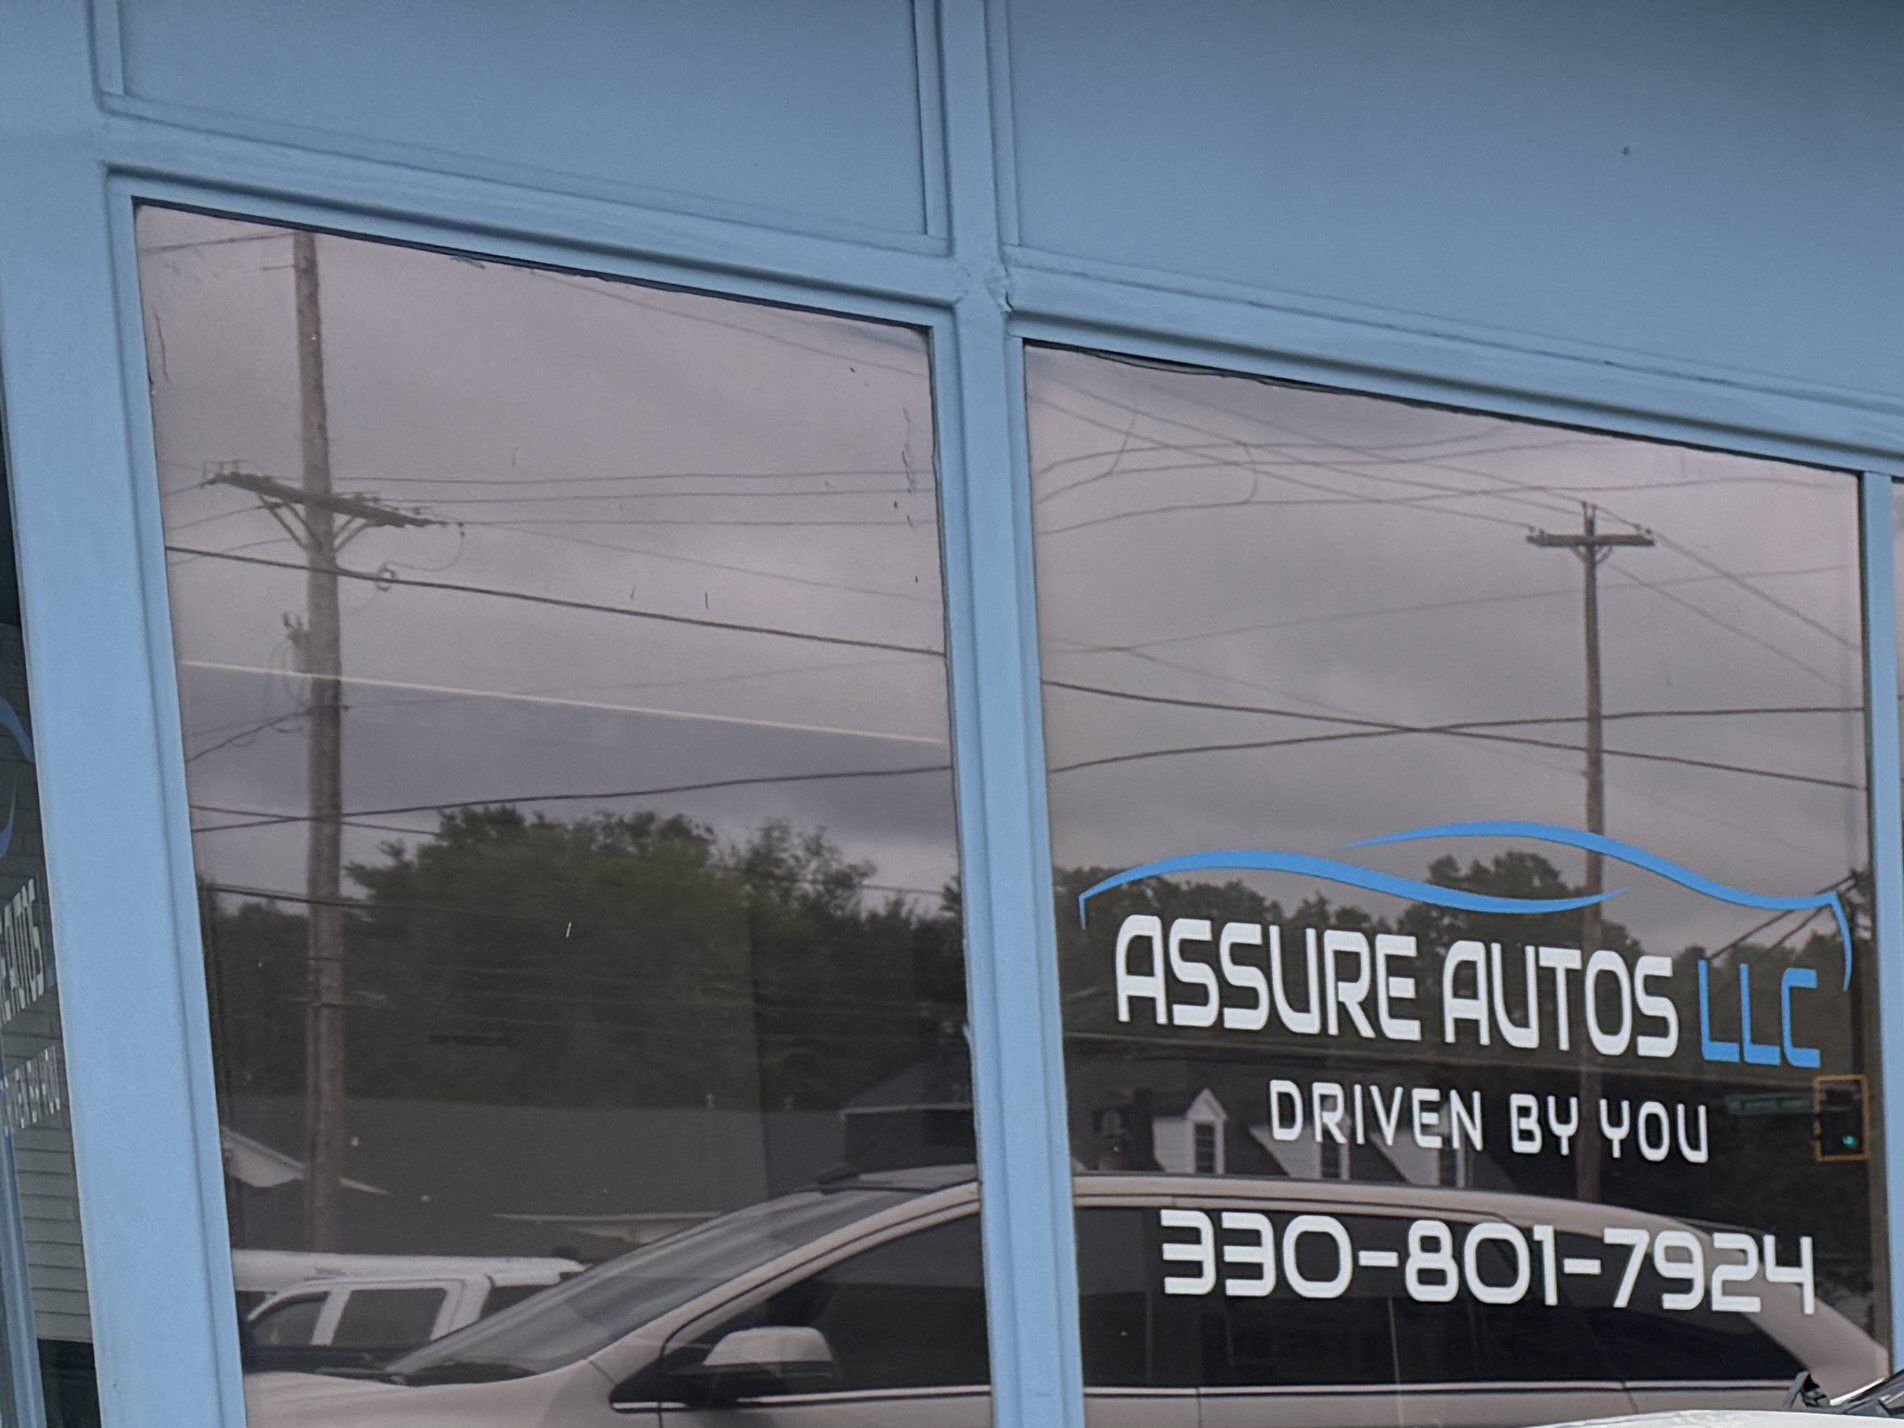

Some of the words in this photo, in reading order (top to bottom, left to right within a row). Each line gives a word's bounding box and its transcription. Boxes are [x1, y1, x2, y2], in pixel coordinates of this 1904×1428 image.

[1115, 914, 1421, 1041] ASSURE
[1442, 940, 1679, 1058] AUTOS
[1698, 961, 1821, 1069] LLC
[1269, 1079, 1482, 1151] DRIVEN
[1510, 1093, 1578, 1155] BY
[1599, 1098, 1708, 1163] YOU
[1160, 1209, 1815, 1315] 330-801-7924
